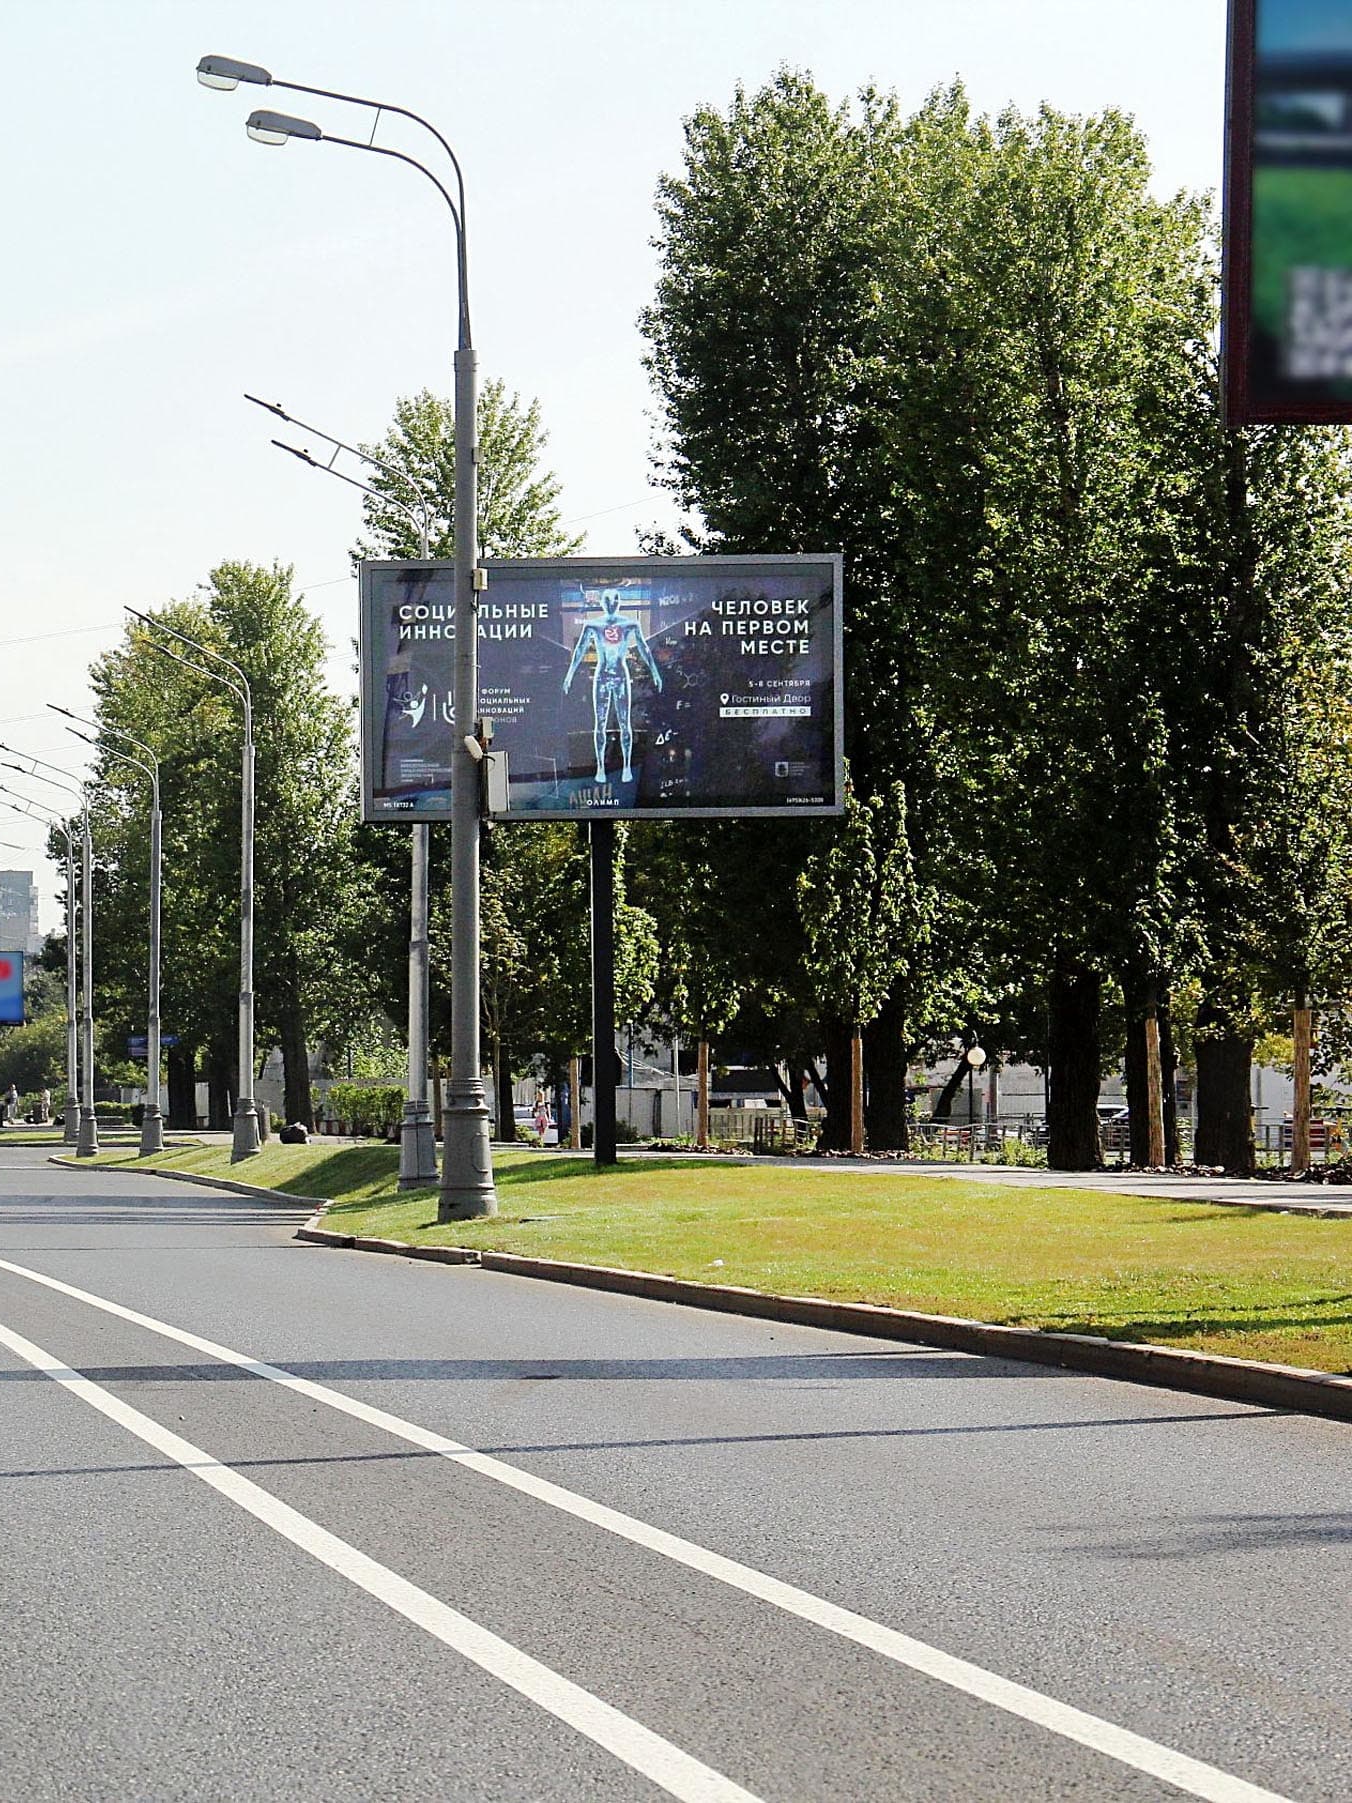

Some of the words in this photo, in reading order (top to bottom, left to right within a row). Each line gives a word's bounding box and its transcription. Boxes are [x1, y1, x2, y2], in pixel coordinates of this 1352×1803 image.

[399, 603, 549, 621] СОЦИЛЬНЫЕ
[711, 599, 809, 615] ЧЕЛОВЕК
[399, 624, 532, 640] ИННОАЦИИ
[684, 621, 712, 636] НА
[722, 620, 809, 635] ПЕРВОМ
[741, 640, 809, 655] МЕСТЕ
[766, 679, 811, 687] СЕНТЯБРЯ
[479, 697, 531, 705] ОЦИАЛЬНЫХ
[732, 694, 781, 704] Гостиный
[782, 693, 812, 704] Двор
[724, 708, 807, 716] БЕСПЛАТНО
[586, 798, 620, 806] ОЛИМП
